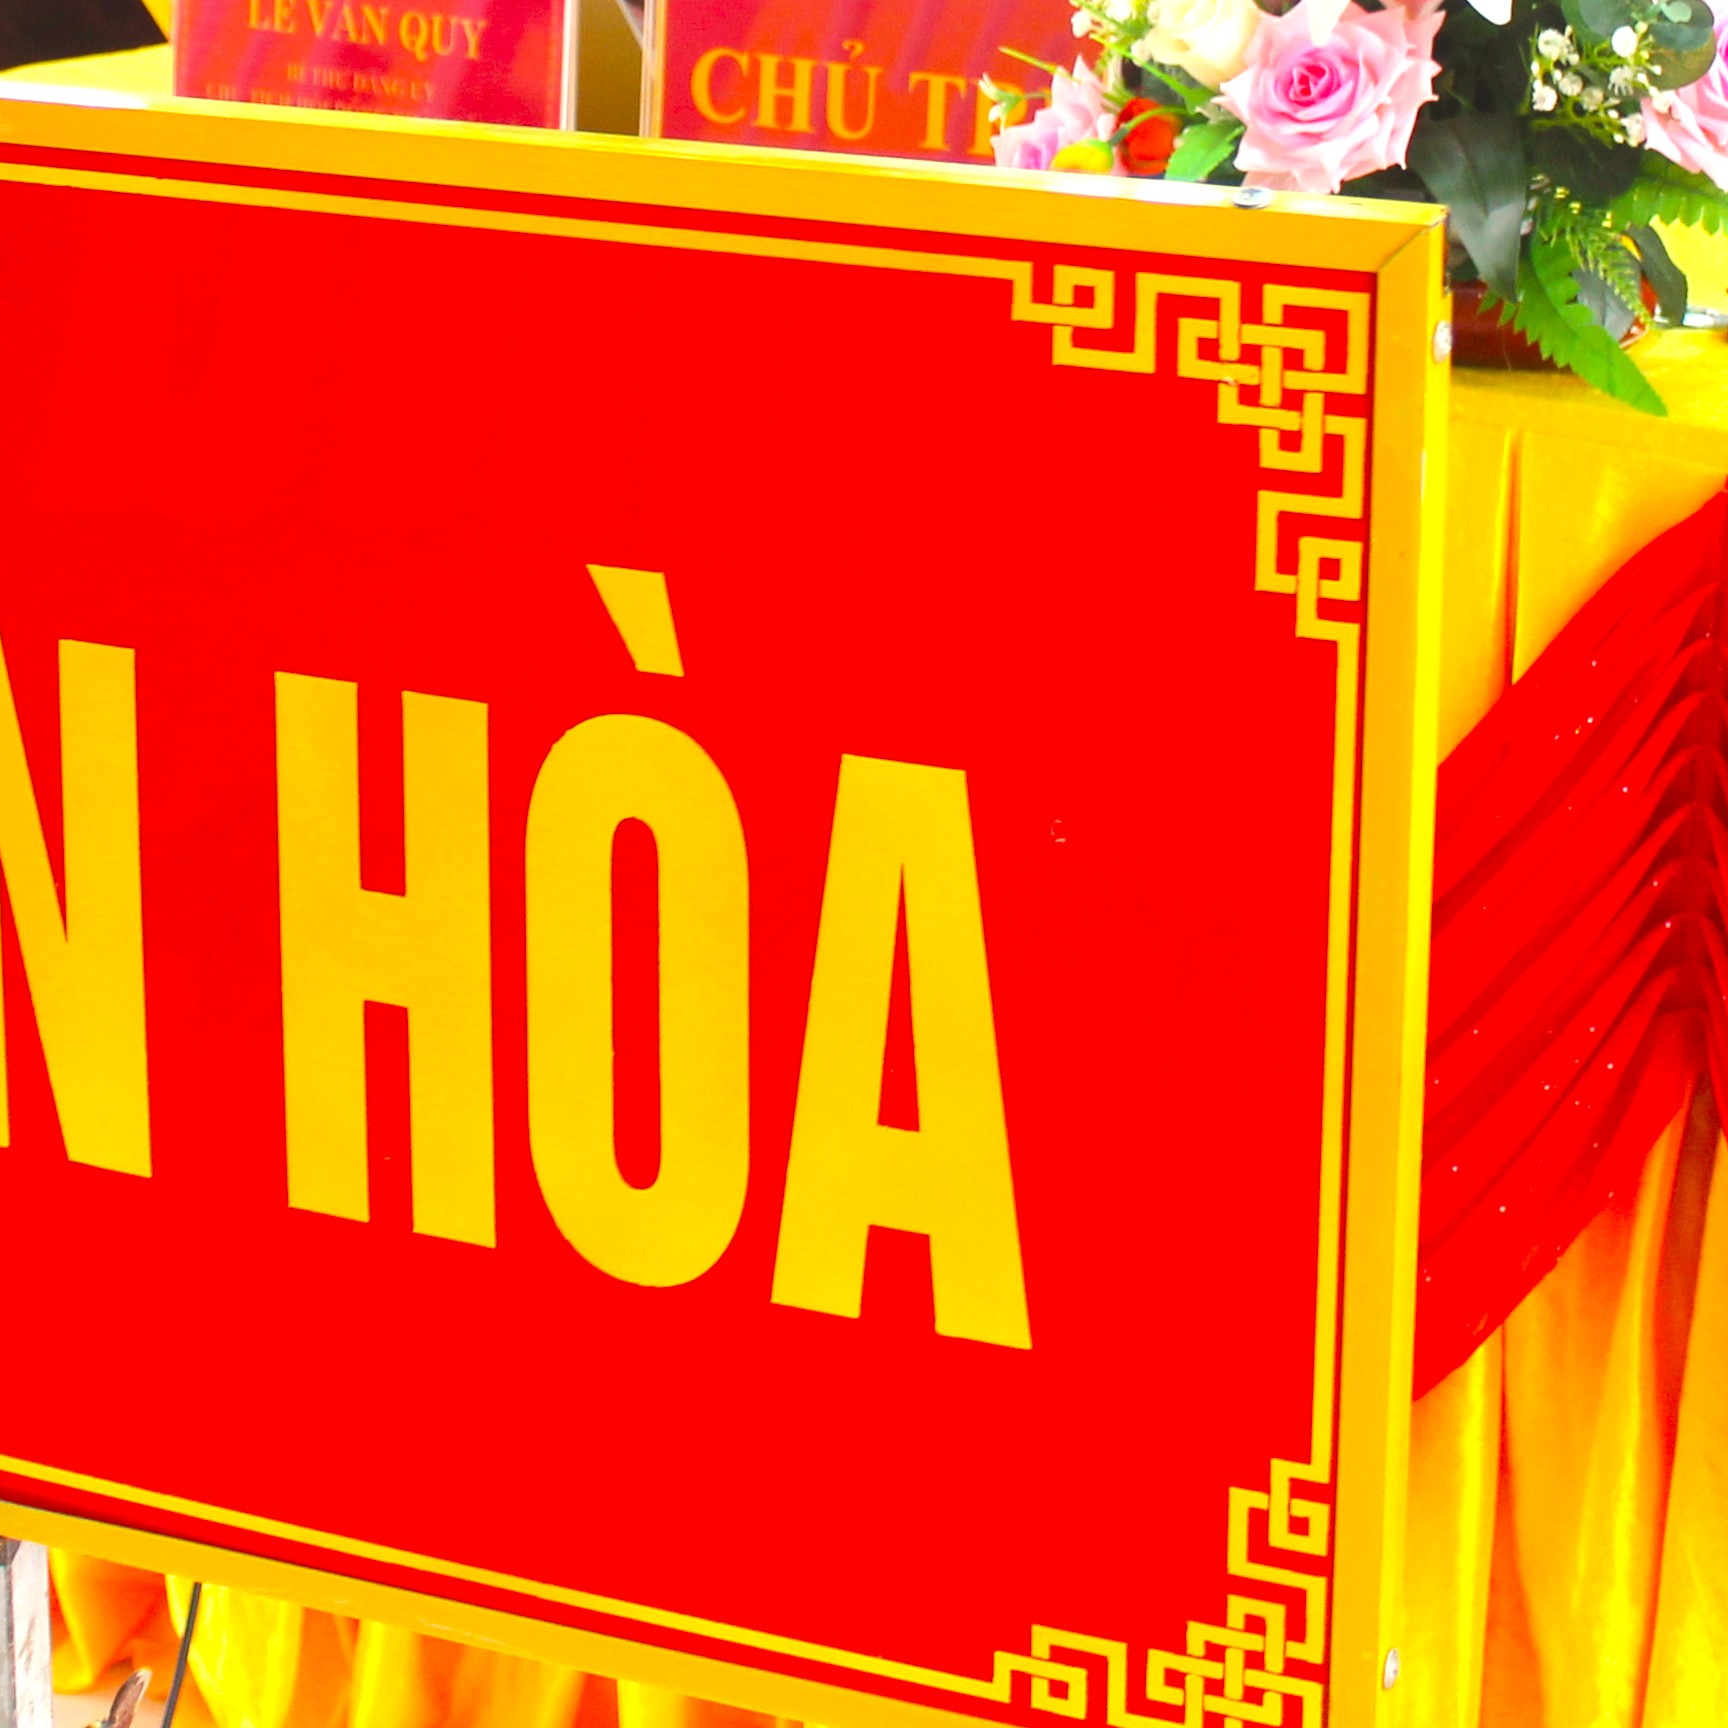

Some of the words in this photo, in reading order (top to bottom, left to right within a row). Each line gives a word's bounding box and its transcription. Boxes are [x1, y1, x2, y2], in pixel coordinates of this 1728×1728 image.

[689, 38, 884, 141] CHỦ
[907, 70, 1056, 158] TR
[274, 563, 1032, 1350] HÒA
